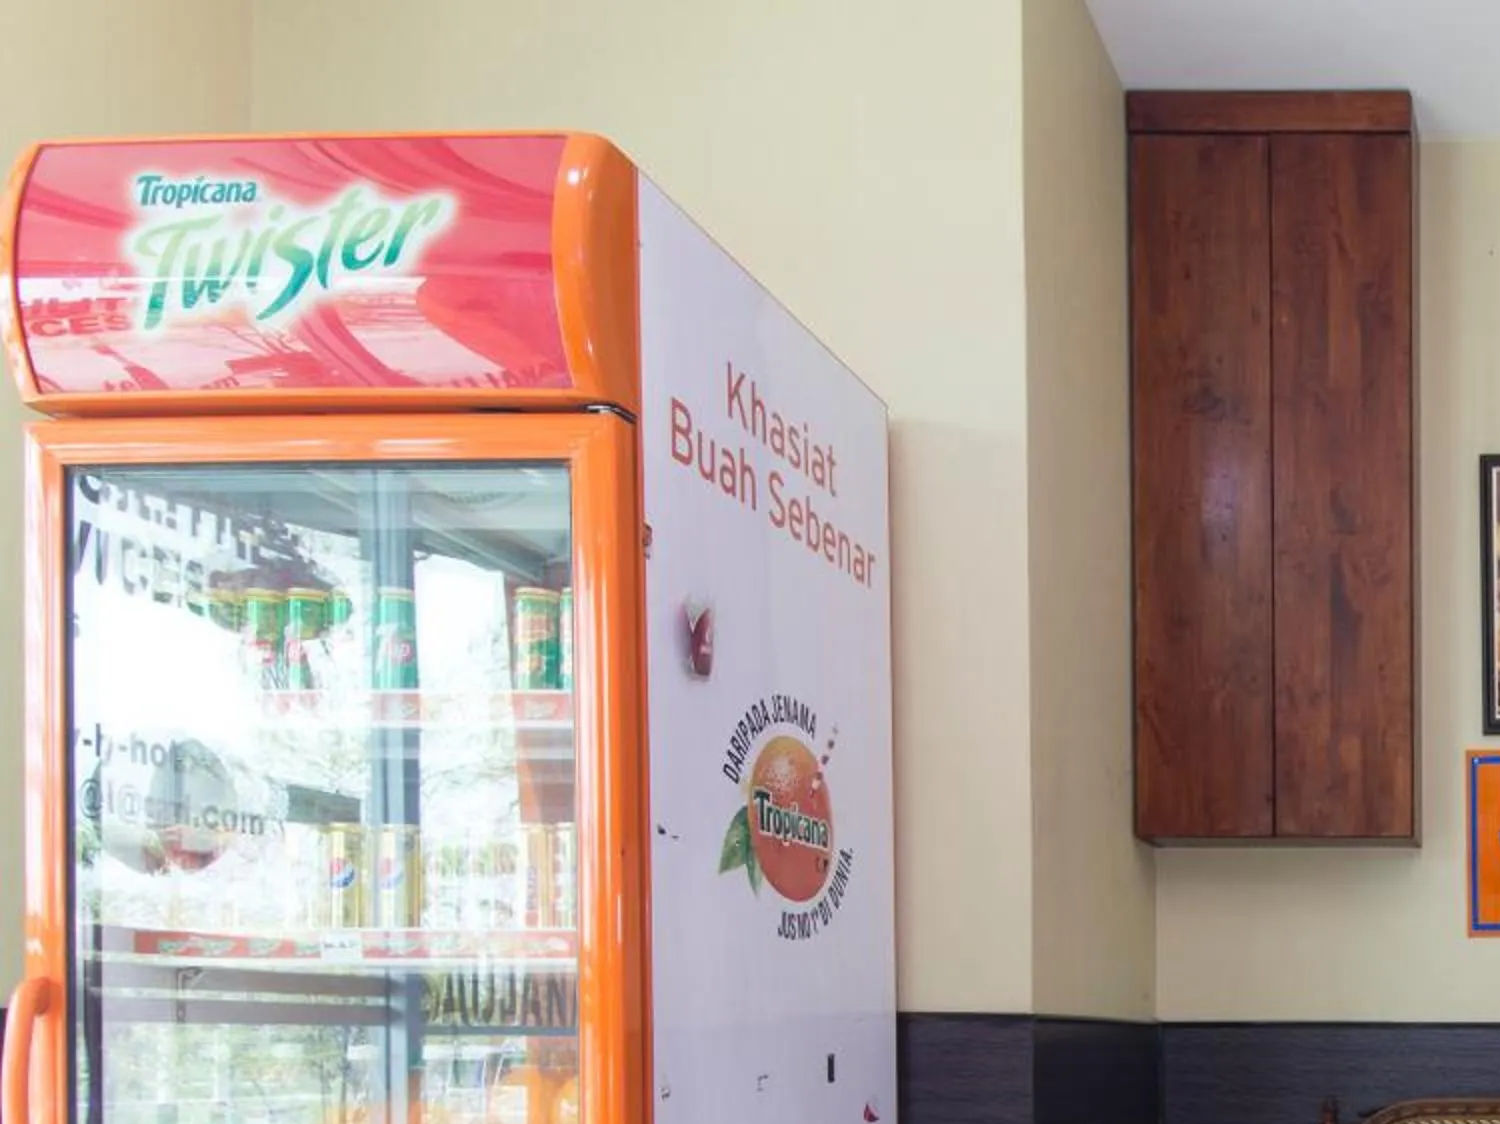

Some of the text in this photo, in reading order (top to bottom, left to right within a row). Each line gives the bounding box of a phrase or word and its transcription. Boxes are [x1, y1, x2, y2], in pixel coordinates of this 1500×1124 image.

[138, 175, 256, 208] Tropicana
[134, 187, 441, 330] Twister
[726, 360, 837, 497] Khasiat
[671, 397, 875, 588] Buah Sebenar
[723, 694, 817, 784] DARIPADA JENAMA
[755, 790, 829, 848] Tropicana
